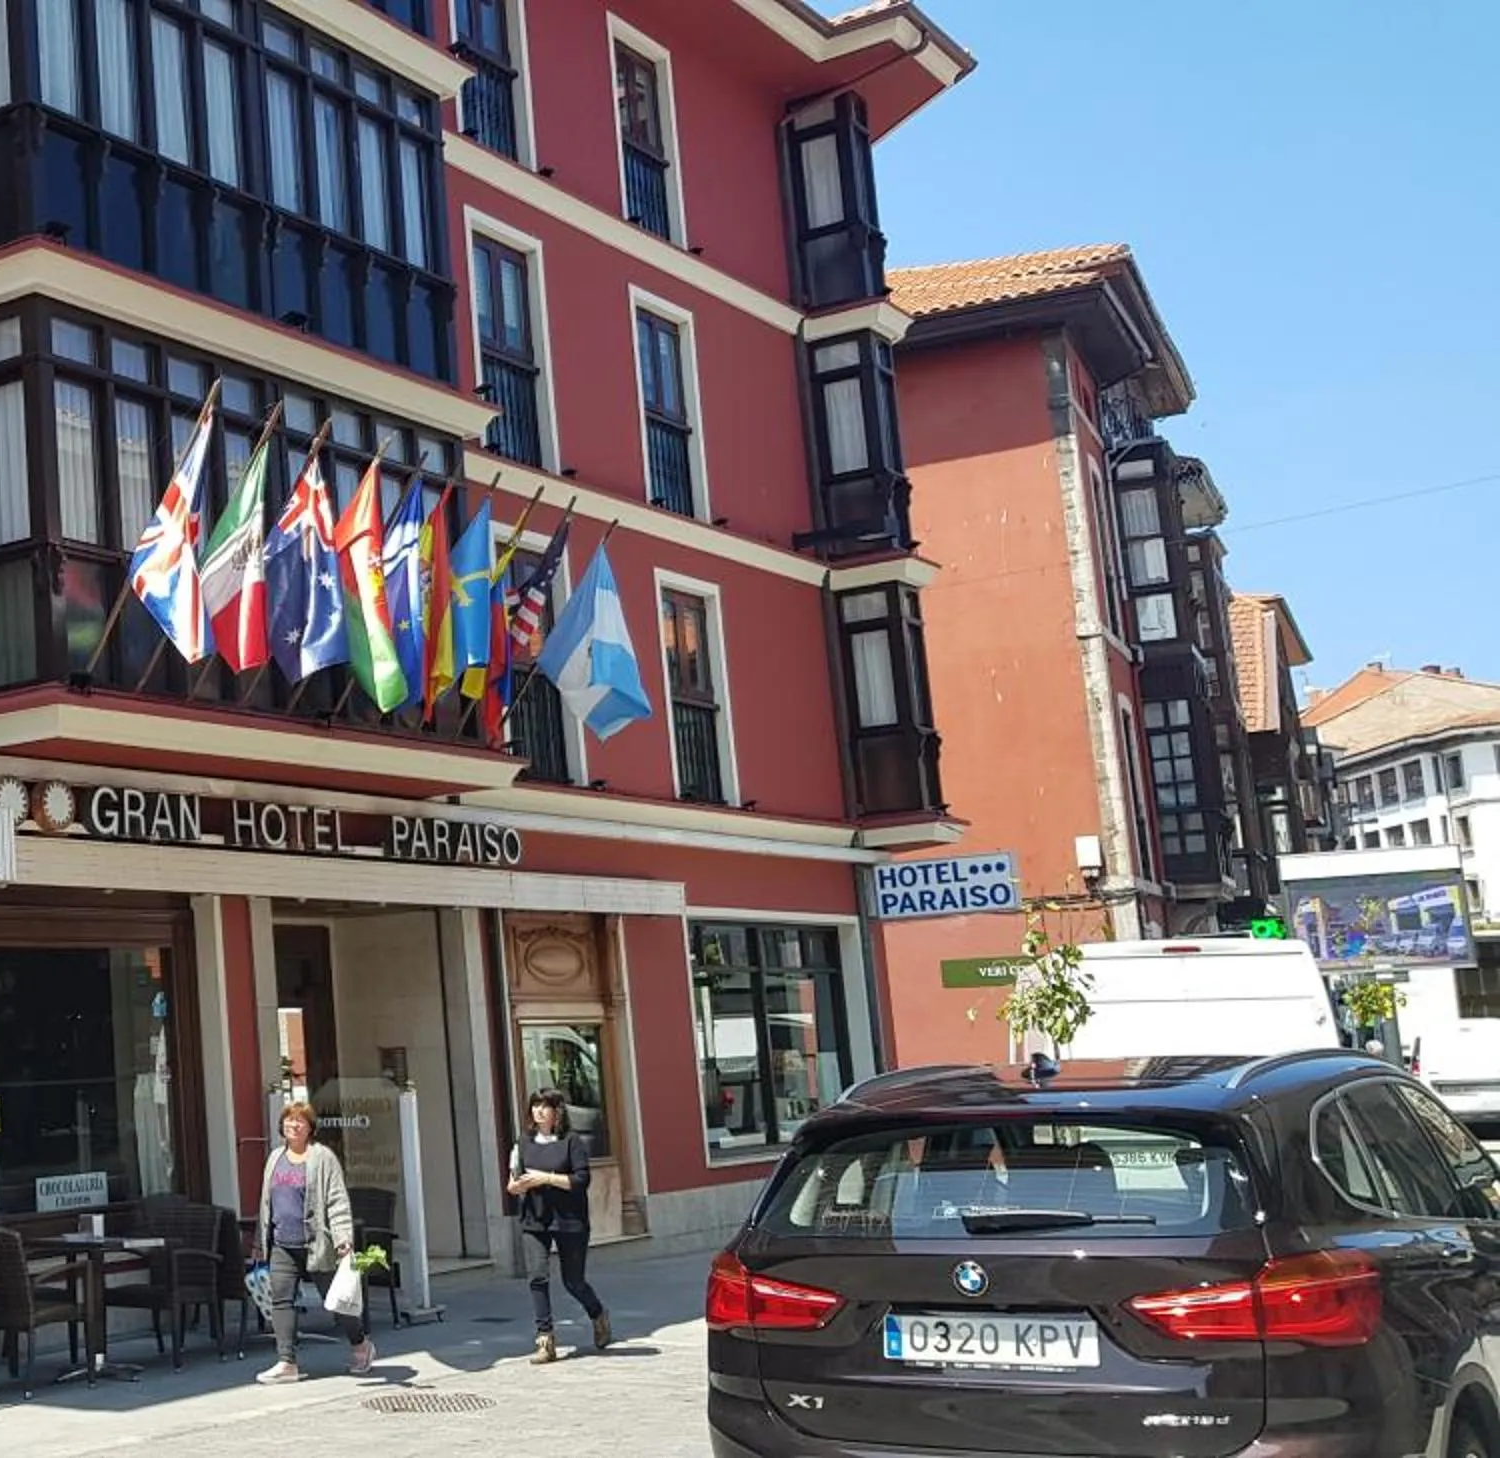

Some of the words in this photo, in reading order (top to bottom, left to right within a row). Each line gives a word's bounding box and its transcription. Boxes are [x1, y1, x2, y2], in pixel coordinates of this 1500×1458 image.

[91, 787, 200, 840] GRAN
[233, 800, 353, 853] HOTEL
[392, 815, 521, 864] PARAISO
[878, 861, 969, 889] HOTEL
[881, 883, 1011, 914] PARAISO
[910, 1320, 999, 1355] 0320
[1014, 1323, 1084, 1358] KPV
[787, 1394, 824, 1409] X1
